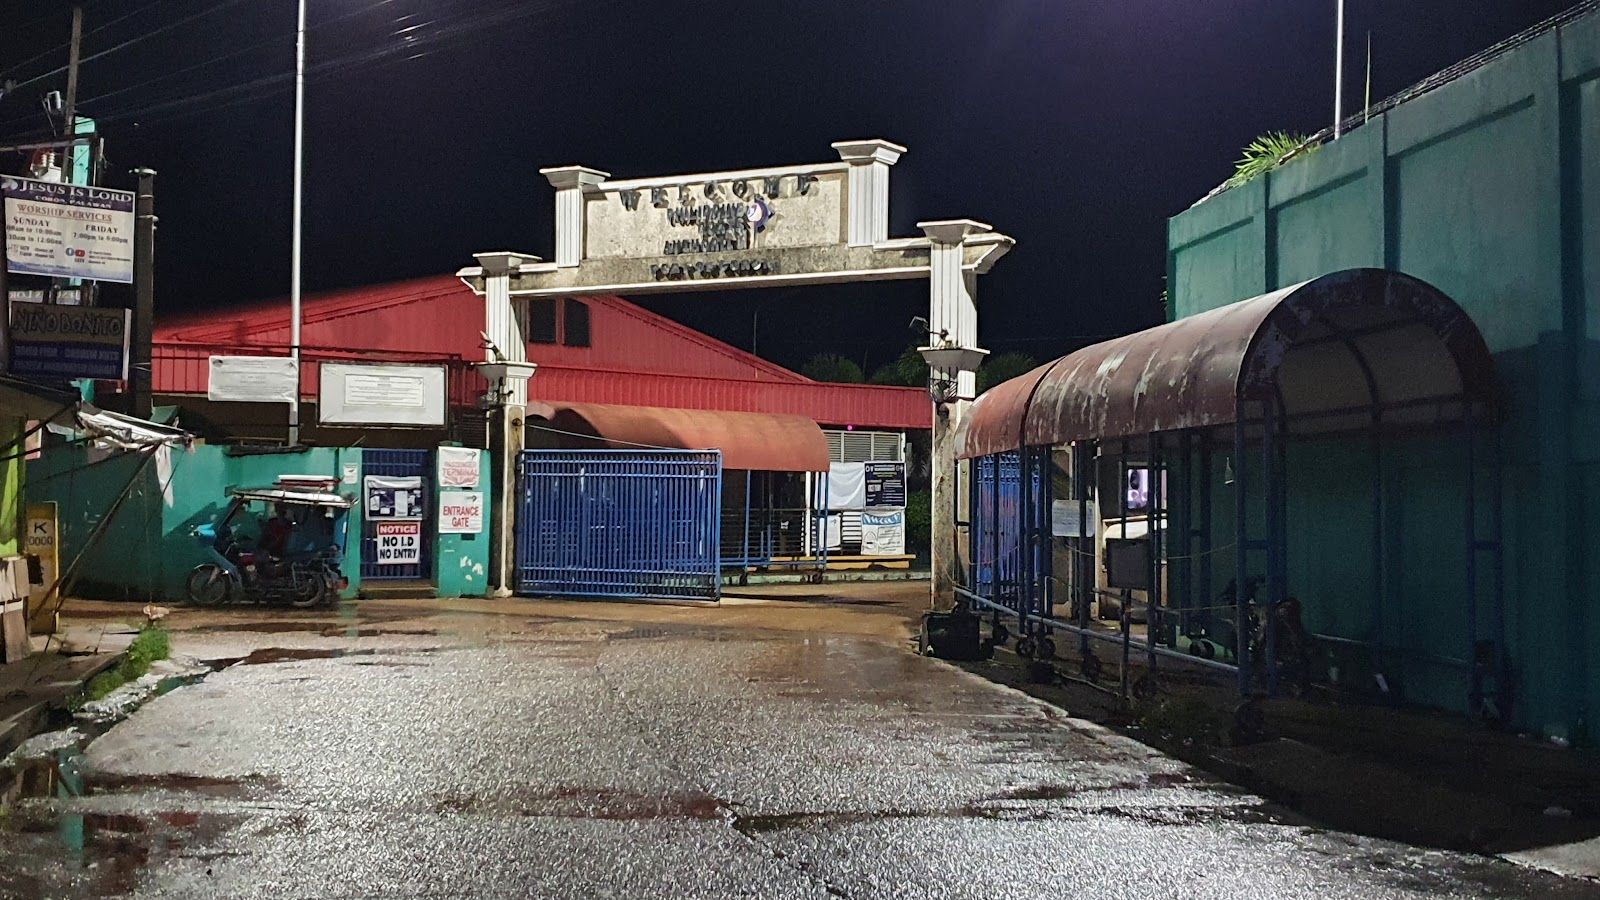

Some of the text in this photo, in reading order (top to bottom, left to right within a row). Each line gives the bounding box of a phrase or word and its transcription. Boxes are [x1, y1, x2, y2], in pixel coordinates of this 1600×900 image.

[19, 180, 132, 203] JESUS IS LORD
[69, 199, 112, 209] PALAWAN
[16, 204, 113, 222] WORSHIP SERVICES
[13, 216, 51, 228] SUNDAY
[85, 224, 119, 234] FRIDAY
[443, 505, 479, 516] ENTRANCE
[34, 521, 47, 534] K
[452, 516, 470, 528] GATE
[379, 525, 417, 534] NOTICE
[382, 536, 398, 547] NO
[379, 548, 418, 559] NO ENTRY
